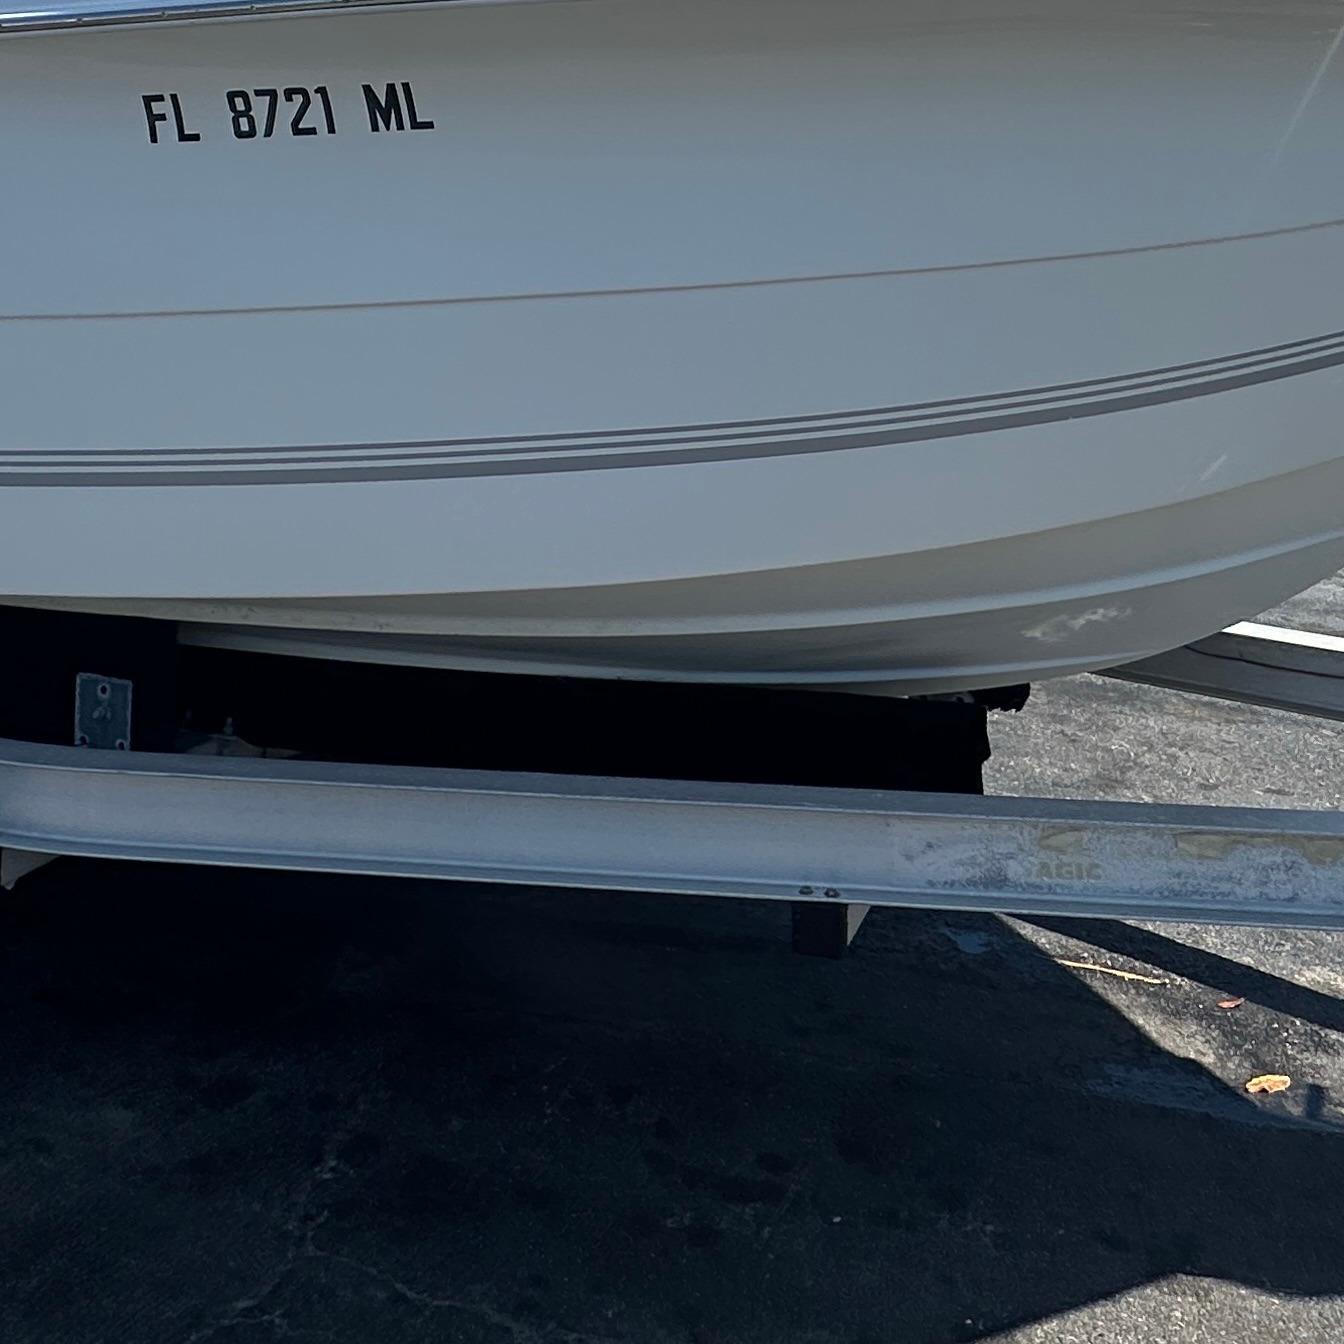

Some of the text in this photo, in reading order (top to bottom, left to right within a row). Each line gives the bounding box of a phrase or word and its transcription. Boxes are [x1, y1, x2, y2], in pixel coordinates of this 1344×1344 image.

[141, 81, 435, 144] FL 8721 ML
